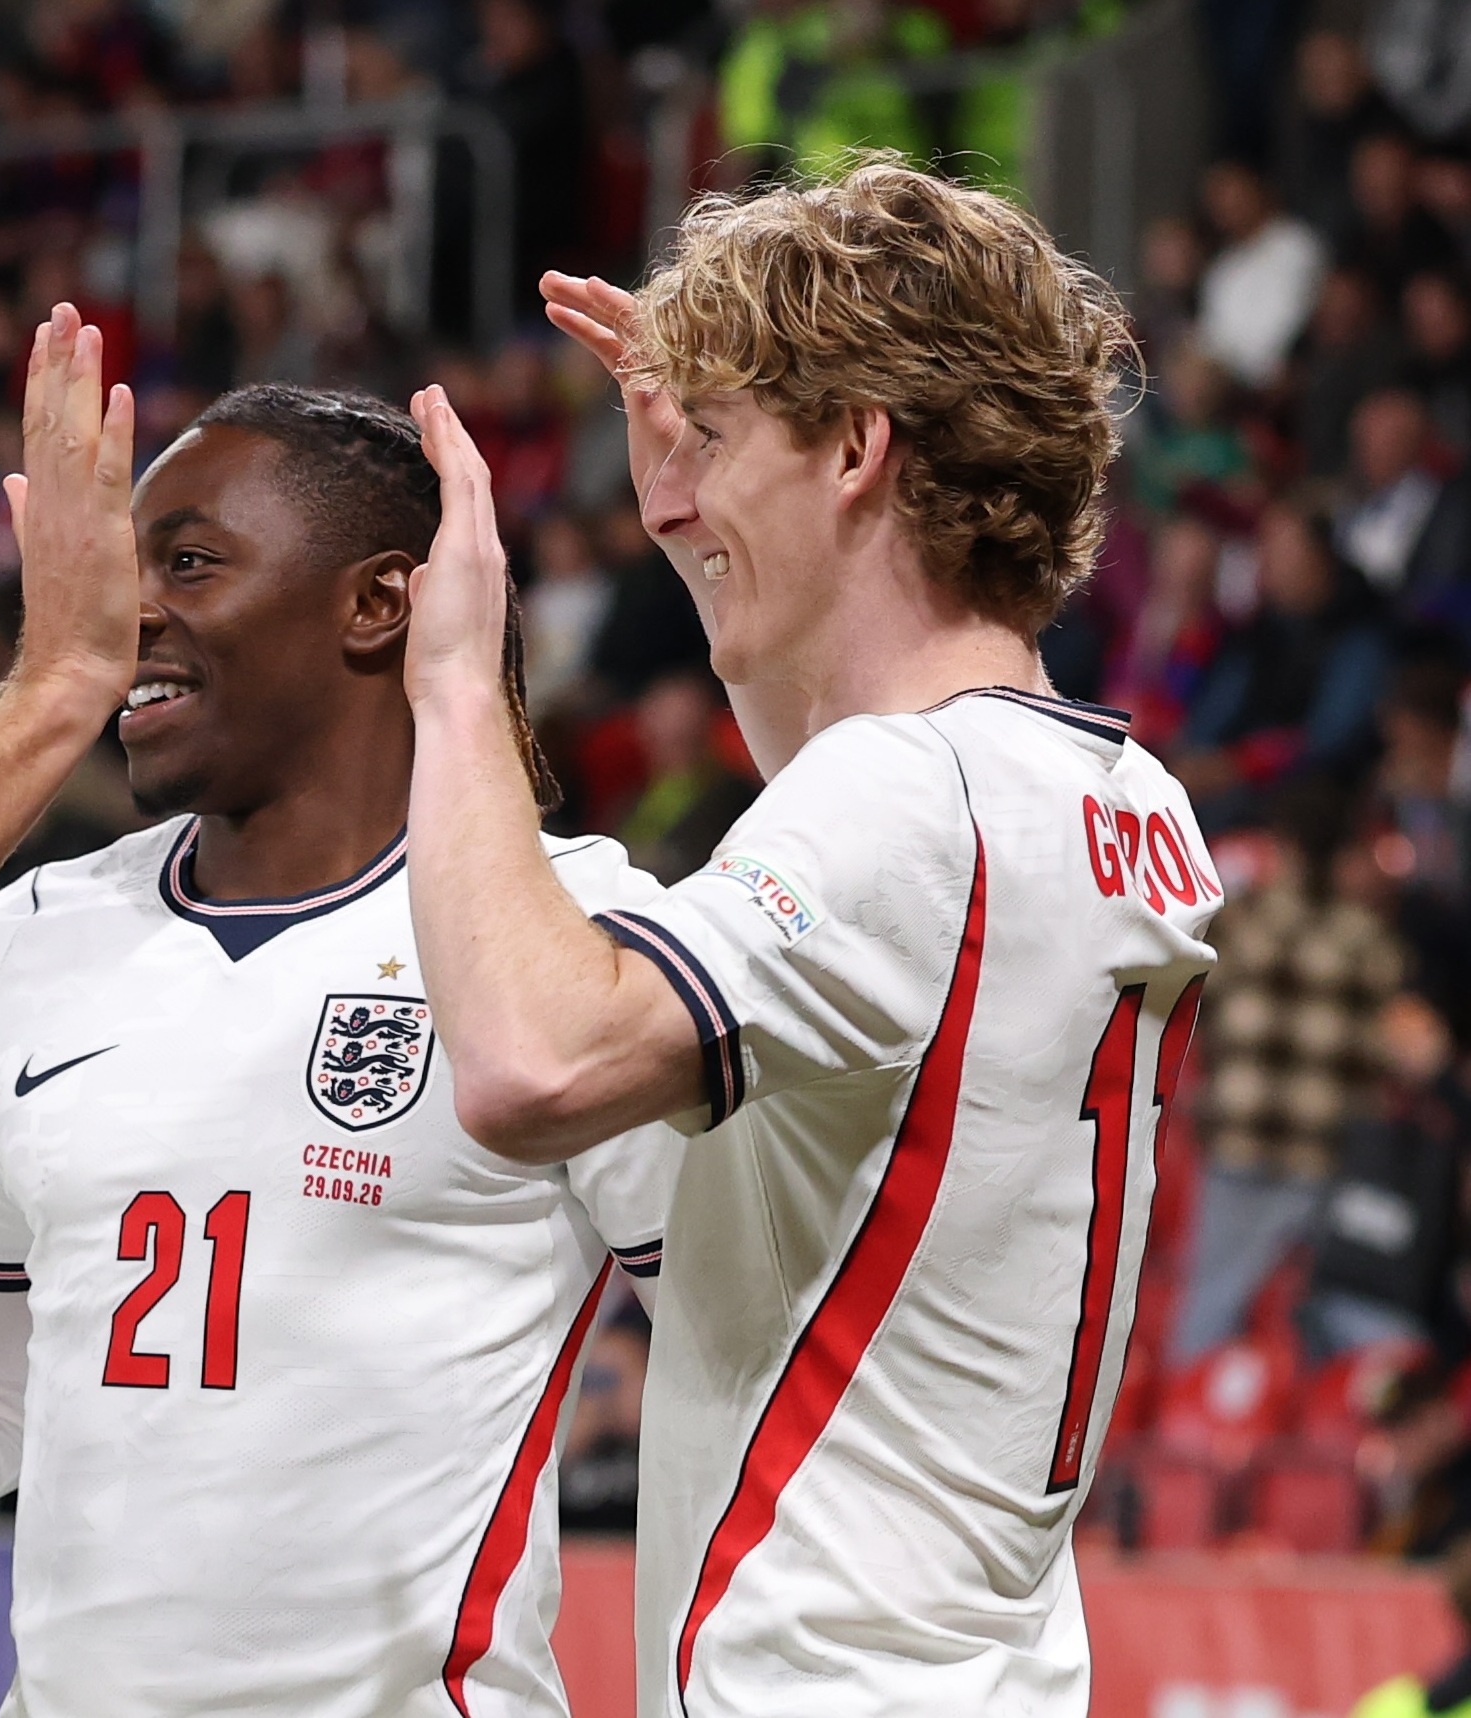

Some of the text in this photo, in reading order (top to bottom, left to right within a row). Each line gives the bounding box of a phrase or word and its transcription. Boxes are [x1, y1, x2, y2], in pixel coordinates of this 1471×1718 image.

[303, 1144, 391, 1178] CZECHIA
[303, 1174, 383, 1207] 29.09.26
[102, 1190, 251, 1390] 21
